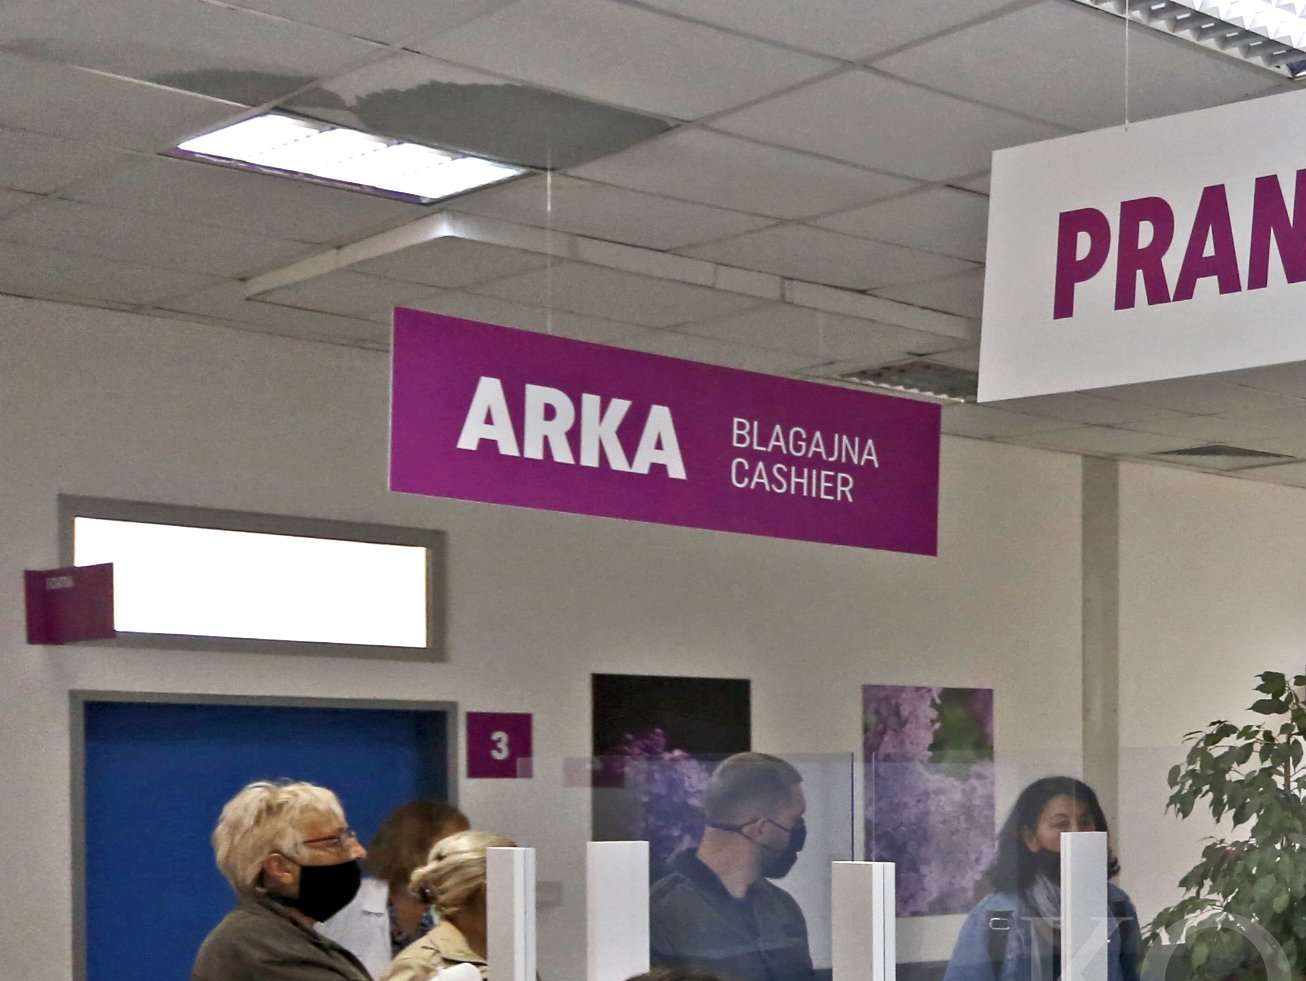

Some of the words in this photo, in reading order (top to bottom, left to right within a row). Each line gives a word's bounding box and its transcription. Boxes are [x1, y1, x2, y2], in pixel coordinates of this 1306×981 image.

[456, 375, 687, 480] ARKA
[732, 417, 880, 468] BLAGAJNA
[730, 457, 854, 503] CASHIER
[489, 730, 510, 761] 3
